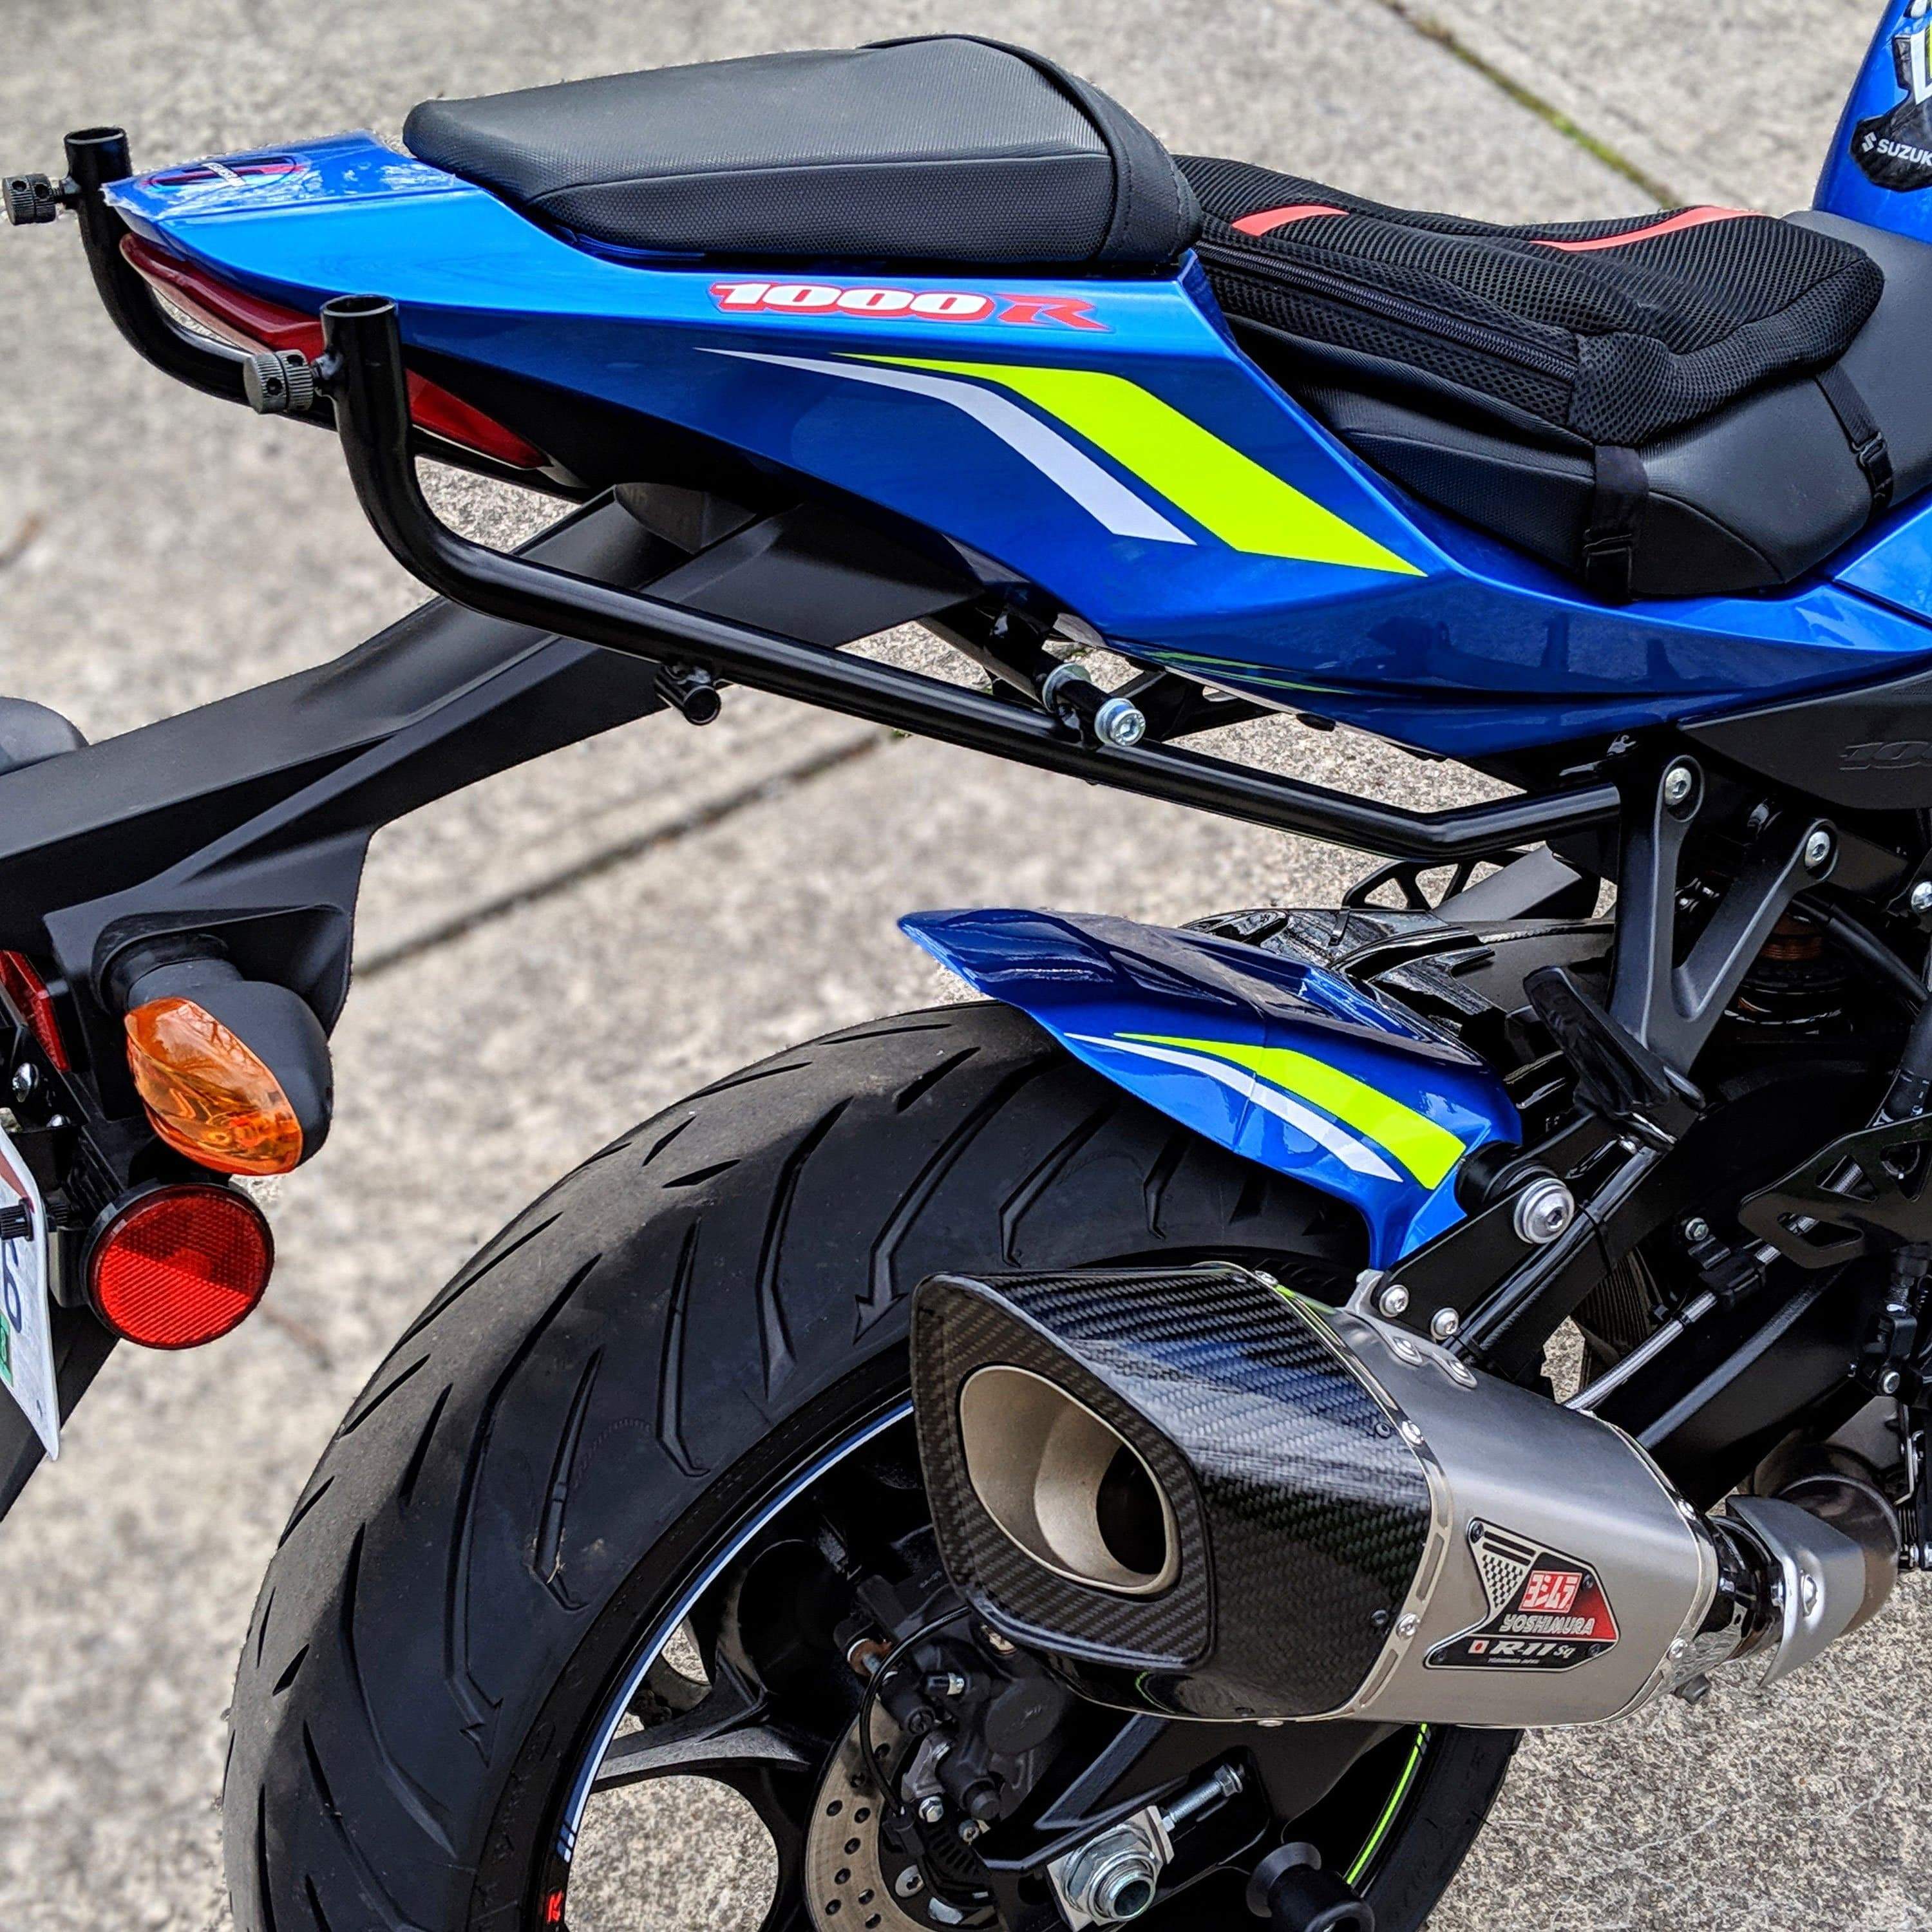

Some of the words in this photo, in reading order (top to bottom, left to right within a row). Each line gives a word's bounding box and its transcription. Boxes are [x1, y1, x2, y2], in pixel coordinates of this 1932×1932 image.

[1499, 1614, 1595, 1636] YOSHIMURA
[1490, 1640, 1557, 1655] R-11
[1553, 1644, 1577, 1659] Sq
